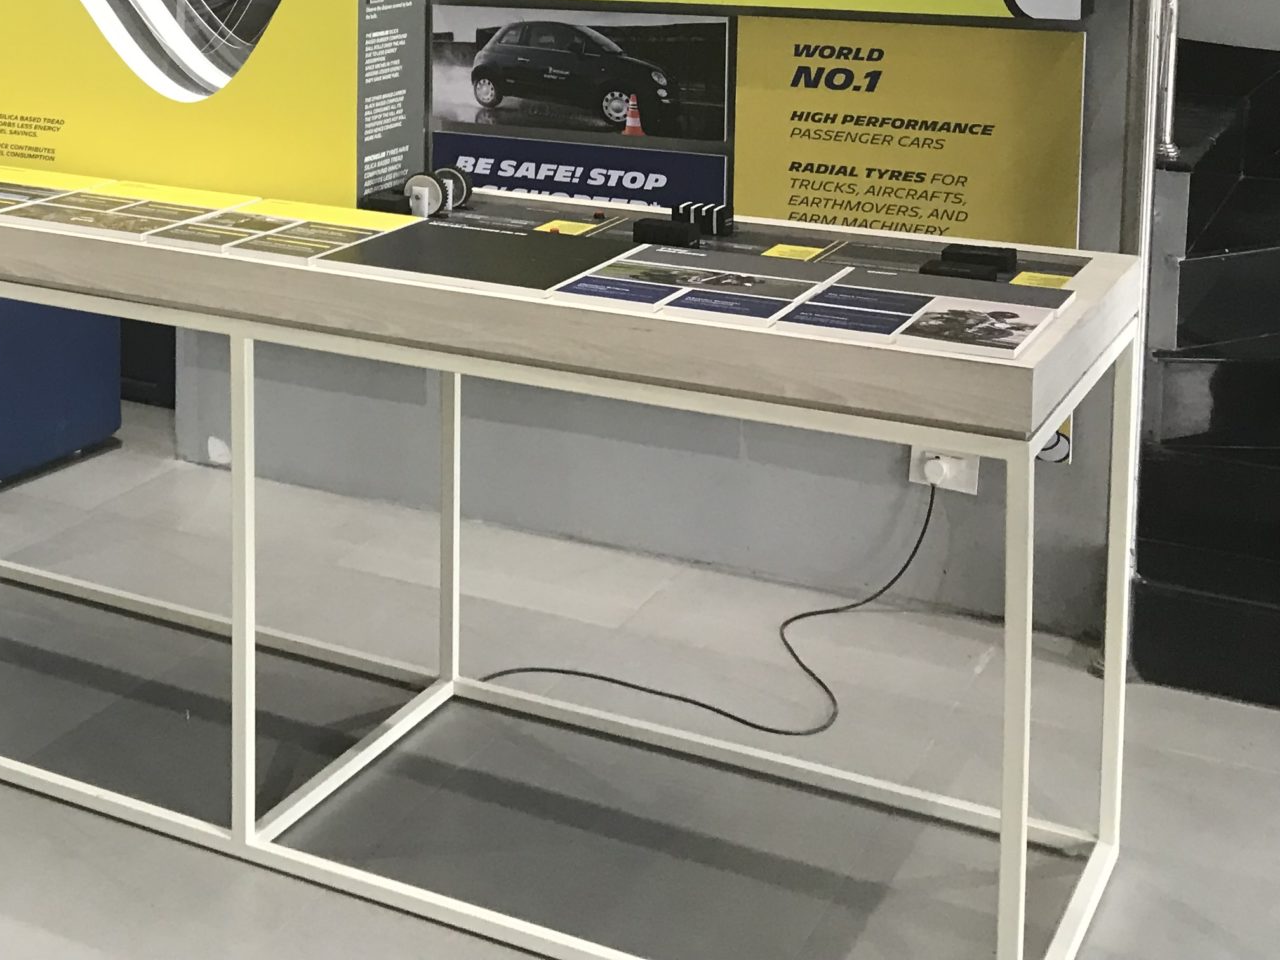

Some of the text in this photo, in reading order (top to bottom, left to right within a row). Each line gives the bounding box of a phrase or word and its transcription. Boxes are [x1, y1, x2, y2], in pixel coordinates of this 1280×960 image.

[793, 44, 884, 63] WORLD
[791, 66, 882, 94] NO.1
[791, 111, 994, 136] HIGH PERFORMANCE
[10, 143, 55, 154] CONTRIBUTES
[790, 127, 945, 151] PASSENGER CARS
[6, 151, 55, 161] CONSUMPTION
[456, 156, 667, 190] BE SAFE! STOP
[788, 161, 968, 187] RADIAL TYRES FOR
[789, 178, 967, 207] TRUCKS, AIRCRAFTS,
[788, 195, 968, 222] EARTHMOVERS, AND
[788, 211, 949, 236] FARM MACHINERY
